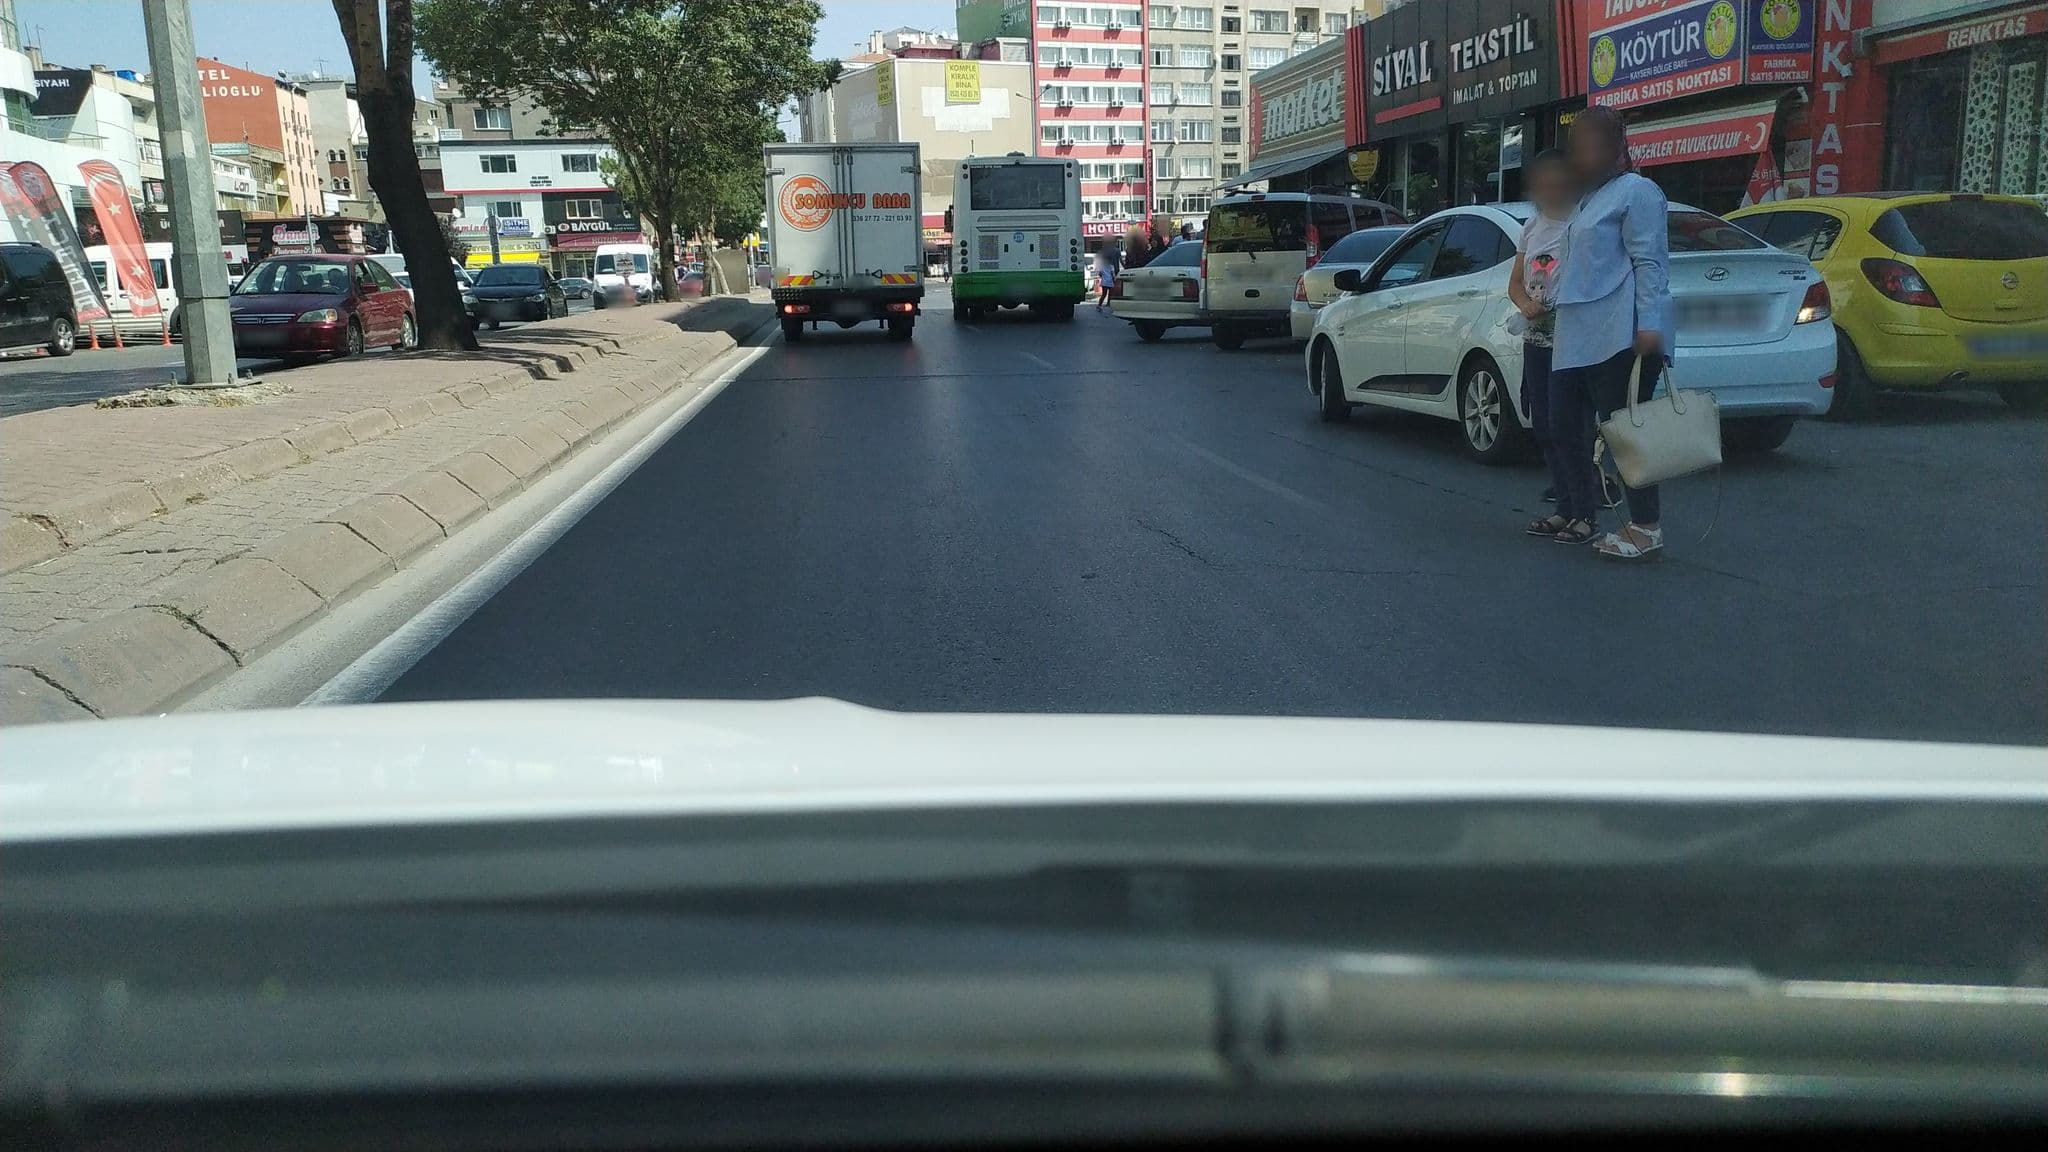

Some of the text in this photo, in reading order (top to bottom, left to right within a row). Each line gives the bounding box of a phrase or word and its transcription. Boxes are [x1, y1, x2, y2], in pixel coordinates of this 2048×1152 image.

[1620, 20, 1701, 69] KÖYTÜR
[1947, 16, 2026, 50] RENKTAS
[949, 64, 977, 72] KOMPLE
[1373, 13, 1534, 97] SİVAL TEKSTİL
[1653, 62, 1673, 75] BÖLGE
[1453, 68, 1537, 105] İMALAT & TOPTAN
[1595, 65, 1732, 107] FABRİKA SATIŞ NOKTASI
[1264, 68, 1341, 142] market
[1675, 131, 1742, 155] TAVUKÇULUK
[794, 192, 912, 209] SOMUNCU BABA
[571, 220, 612, 231] BAYGÜL
[1088, 223, 1128, 233] HOTEL
